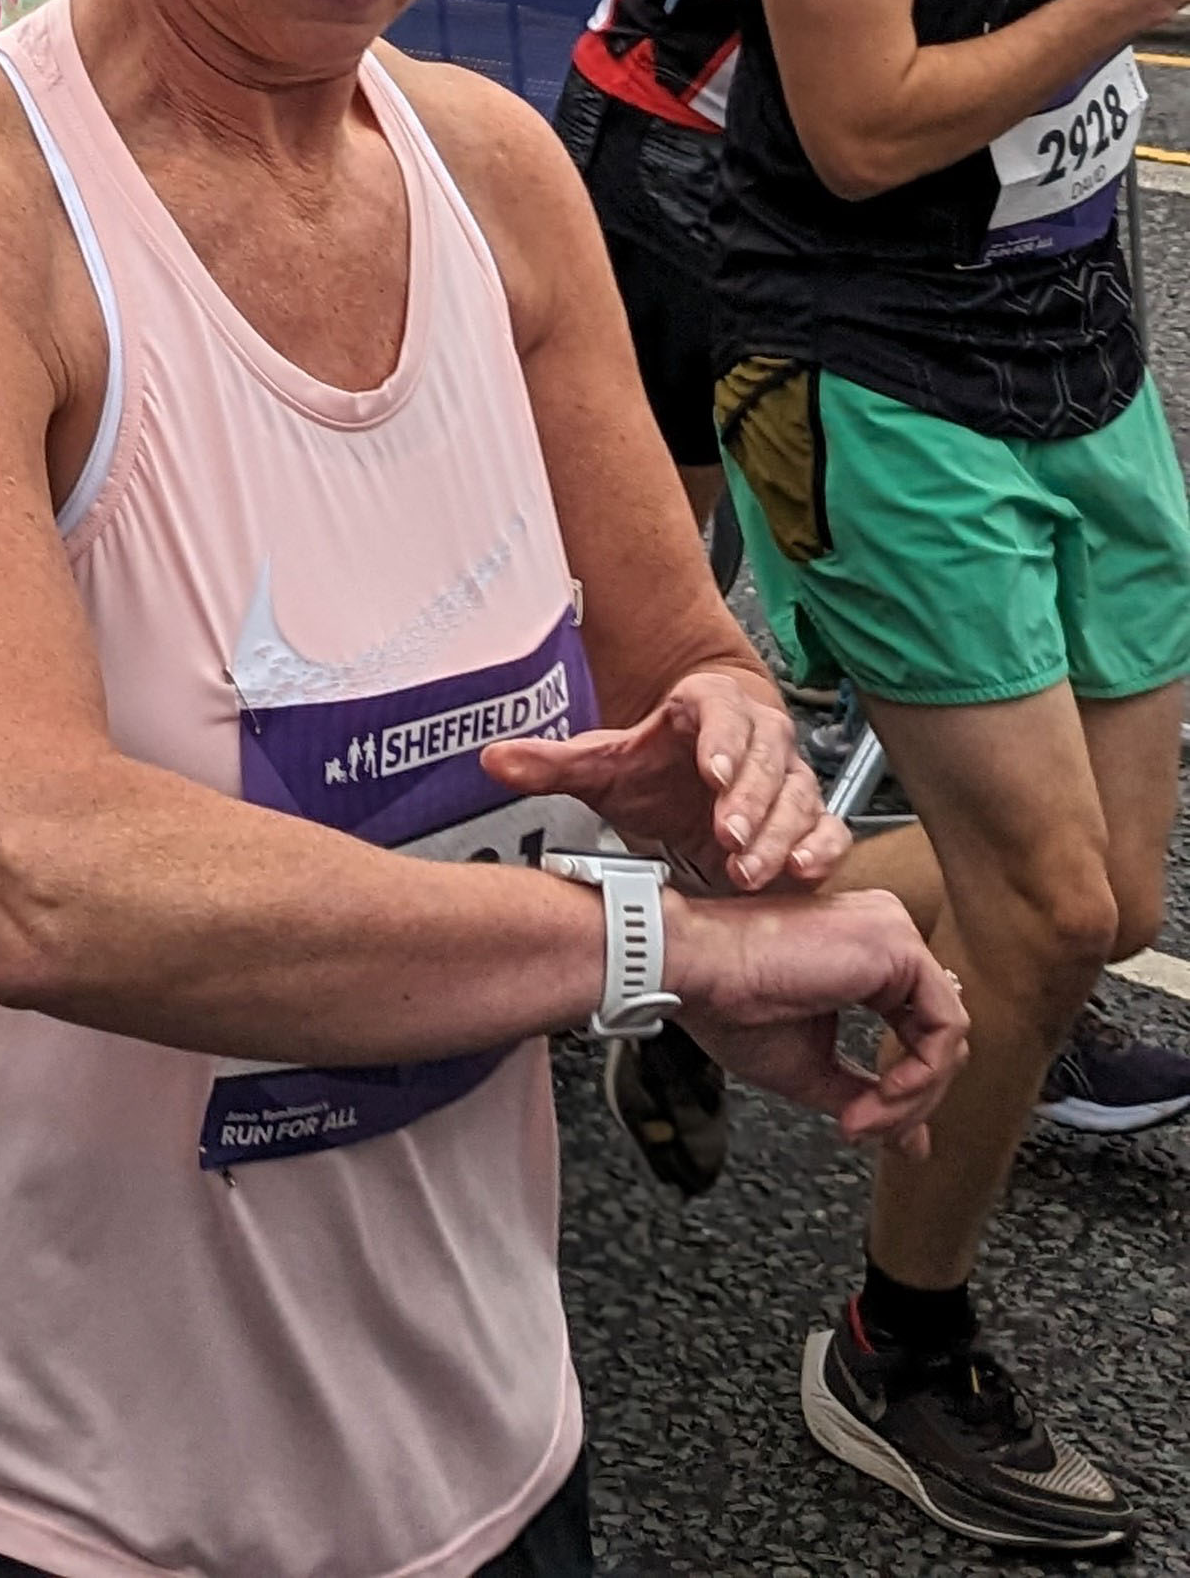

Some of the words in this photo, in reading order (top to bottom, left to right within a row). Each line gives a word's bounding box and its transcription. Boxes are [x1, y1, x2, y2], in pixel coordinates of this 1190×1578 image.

[1037, 84, 1129, 186] 2928
[385, 696, 530, 768] SHEFFIELD
[536, 670, 566, 721] 10K
[220, 1124, 273, 1146] RUN
[276, 1116, 320, 1141] FOR
[322, 1106, 359, 1133] ALL
